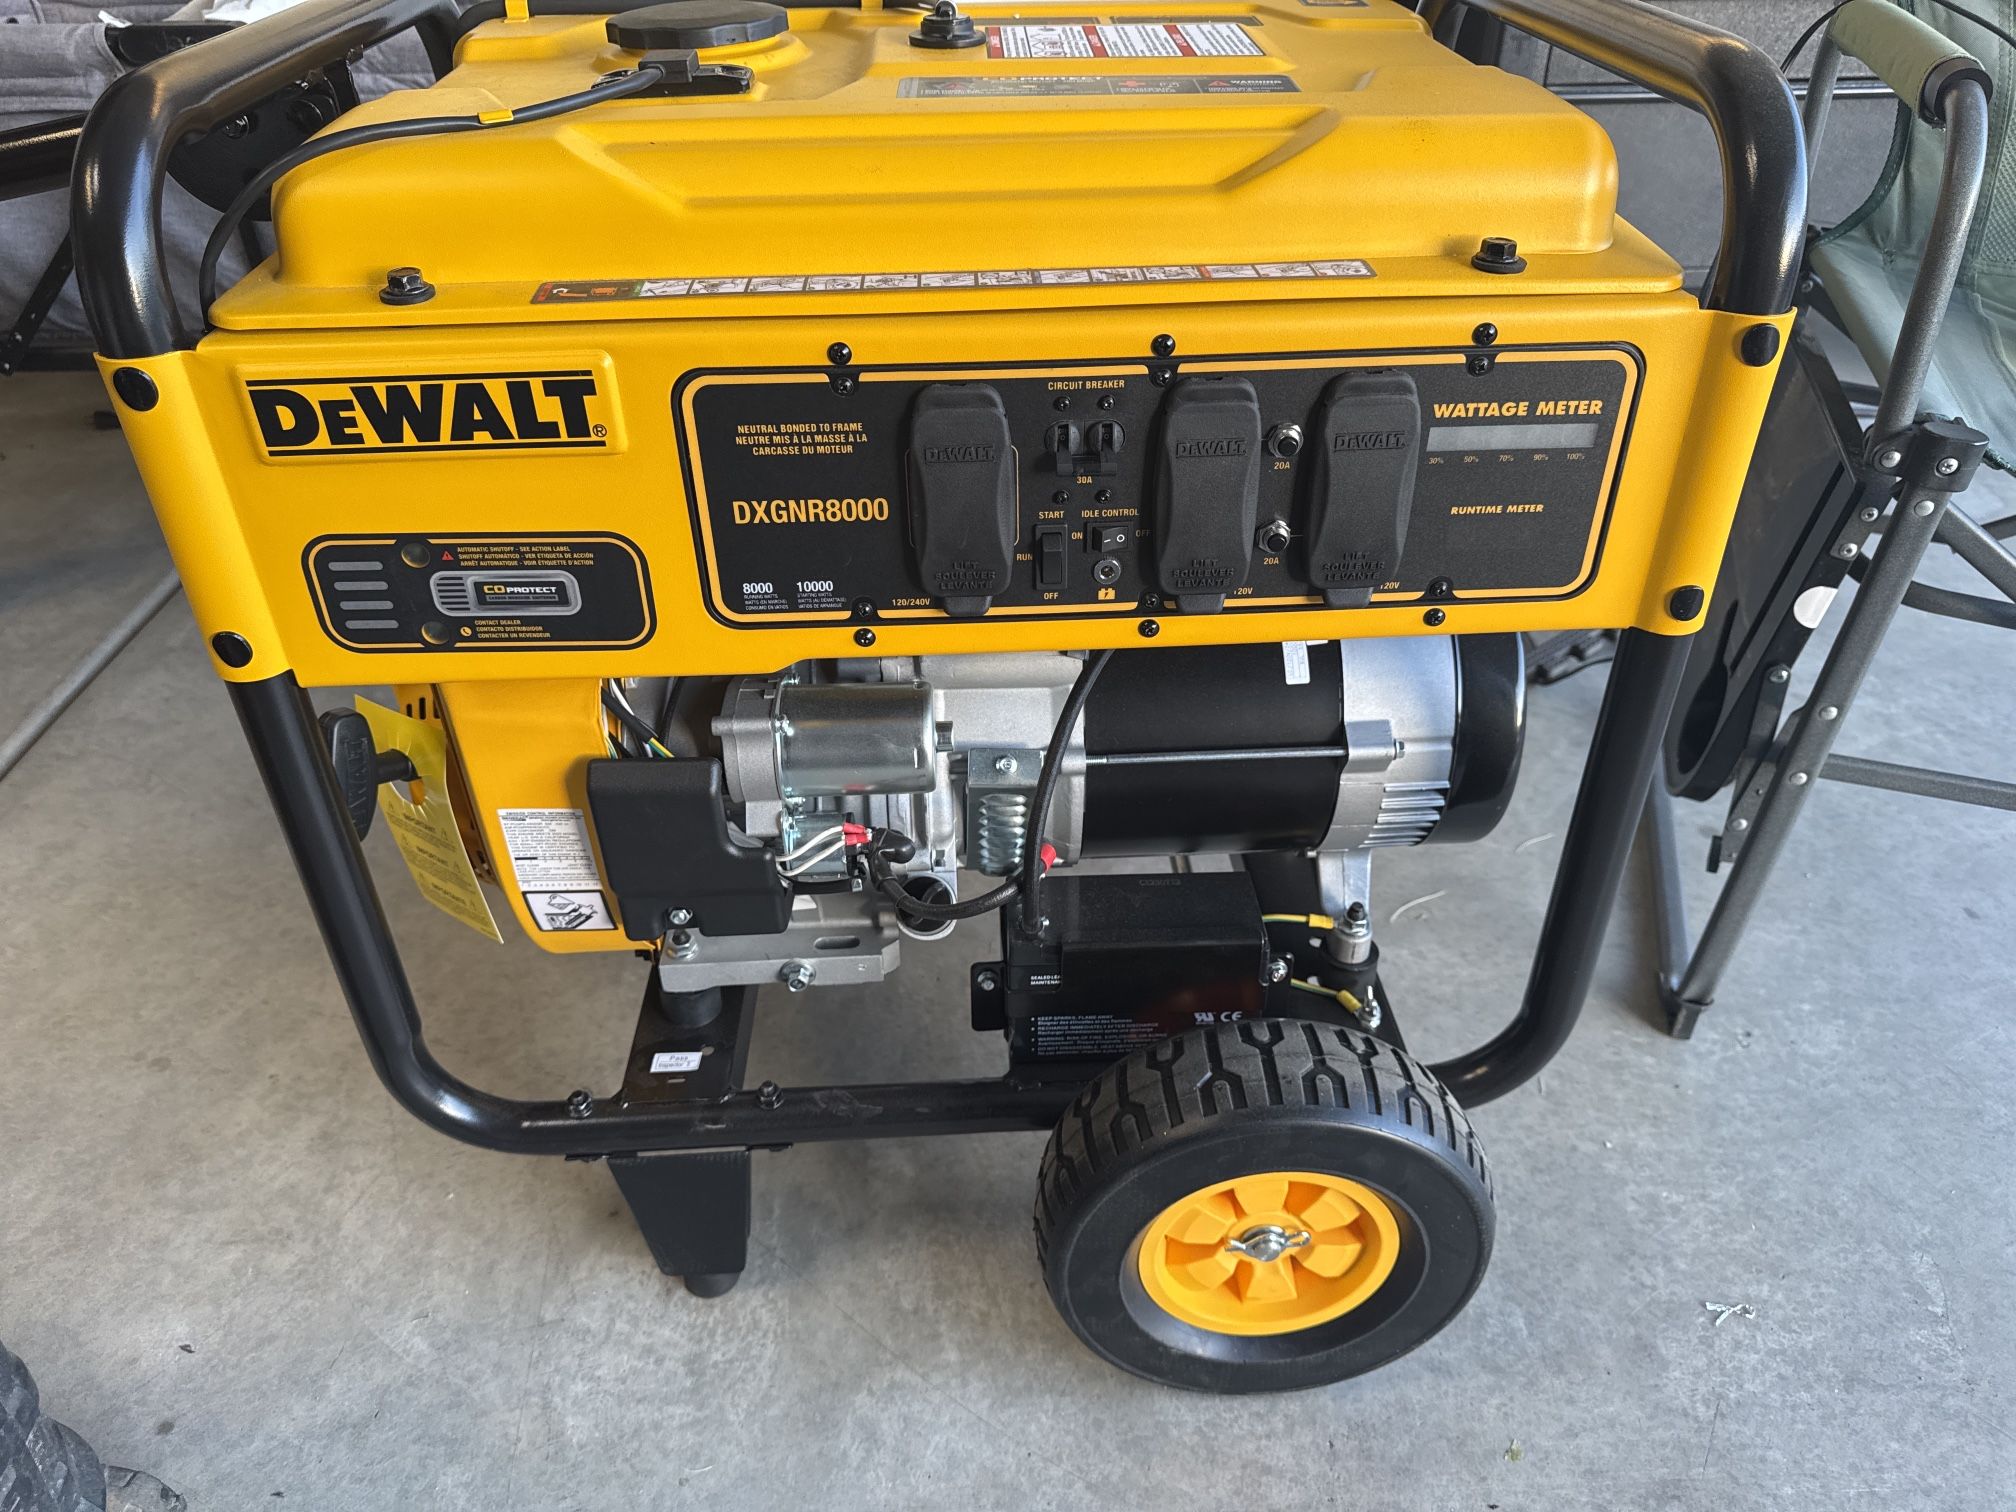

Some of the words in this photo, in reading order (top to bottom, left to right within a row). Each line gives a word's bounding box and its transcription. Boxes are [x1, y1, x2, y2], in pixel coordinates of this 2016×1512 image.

[1048, 381, 1083, 391] CIRCUIT
[1086, 380, 1125, 390] BREAKER
[1433, 402, 1529, 418] WATTAGE
[1536, 400, 1603, 416] METER
[738, 424, 778, 434] NEUTRAL
[780, 424, 816, 432] BONDED
[819, 423, 830, 432] TO
[832, 422, 862, 432] FRAME
[736, 436, 770, 444] NEUTRE
[772, 435, 790, 444] MIS
[801, 434, 812, 443] LA
[814, 434, 846, 443] MASSE
[856, 434, 868, 442] LA
[752, 446, 800, 456] CARCASSE
[802, 446, 814, 454] DU
[816, 445, 854, 454] MOTEUR
[1499, 454, 1514, 462] 70%
[1274, 462, 1290, 470] 20A
[1076, 476, 1092, 484] 30A
[732, 498, 888, 524] DXGNR8000
[1082, 510, 1100, 518] IDLE
[1102, 508, 1140, 517] CONTROL
[1450, 506, 1502, 515] RUNTIME
[1506, 504, 1544, 513] METER
[1038, 510, 1064, 519] START
[1072, 532, 1083, 540] ON
[1136, 530, 1150, 538] OFF
[1016, 553, 1033, 561] RUN
[742, 582, 773, 594] 8000
[796, 581, 834, 592] 10000
[1044, 592, 1058, 600] OFF
[892, 598, 930, 606] 120/240V
